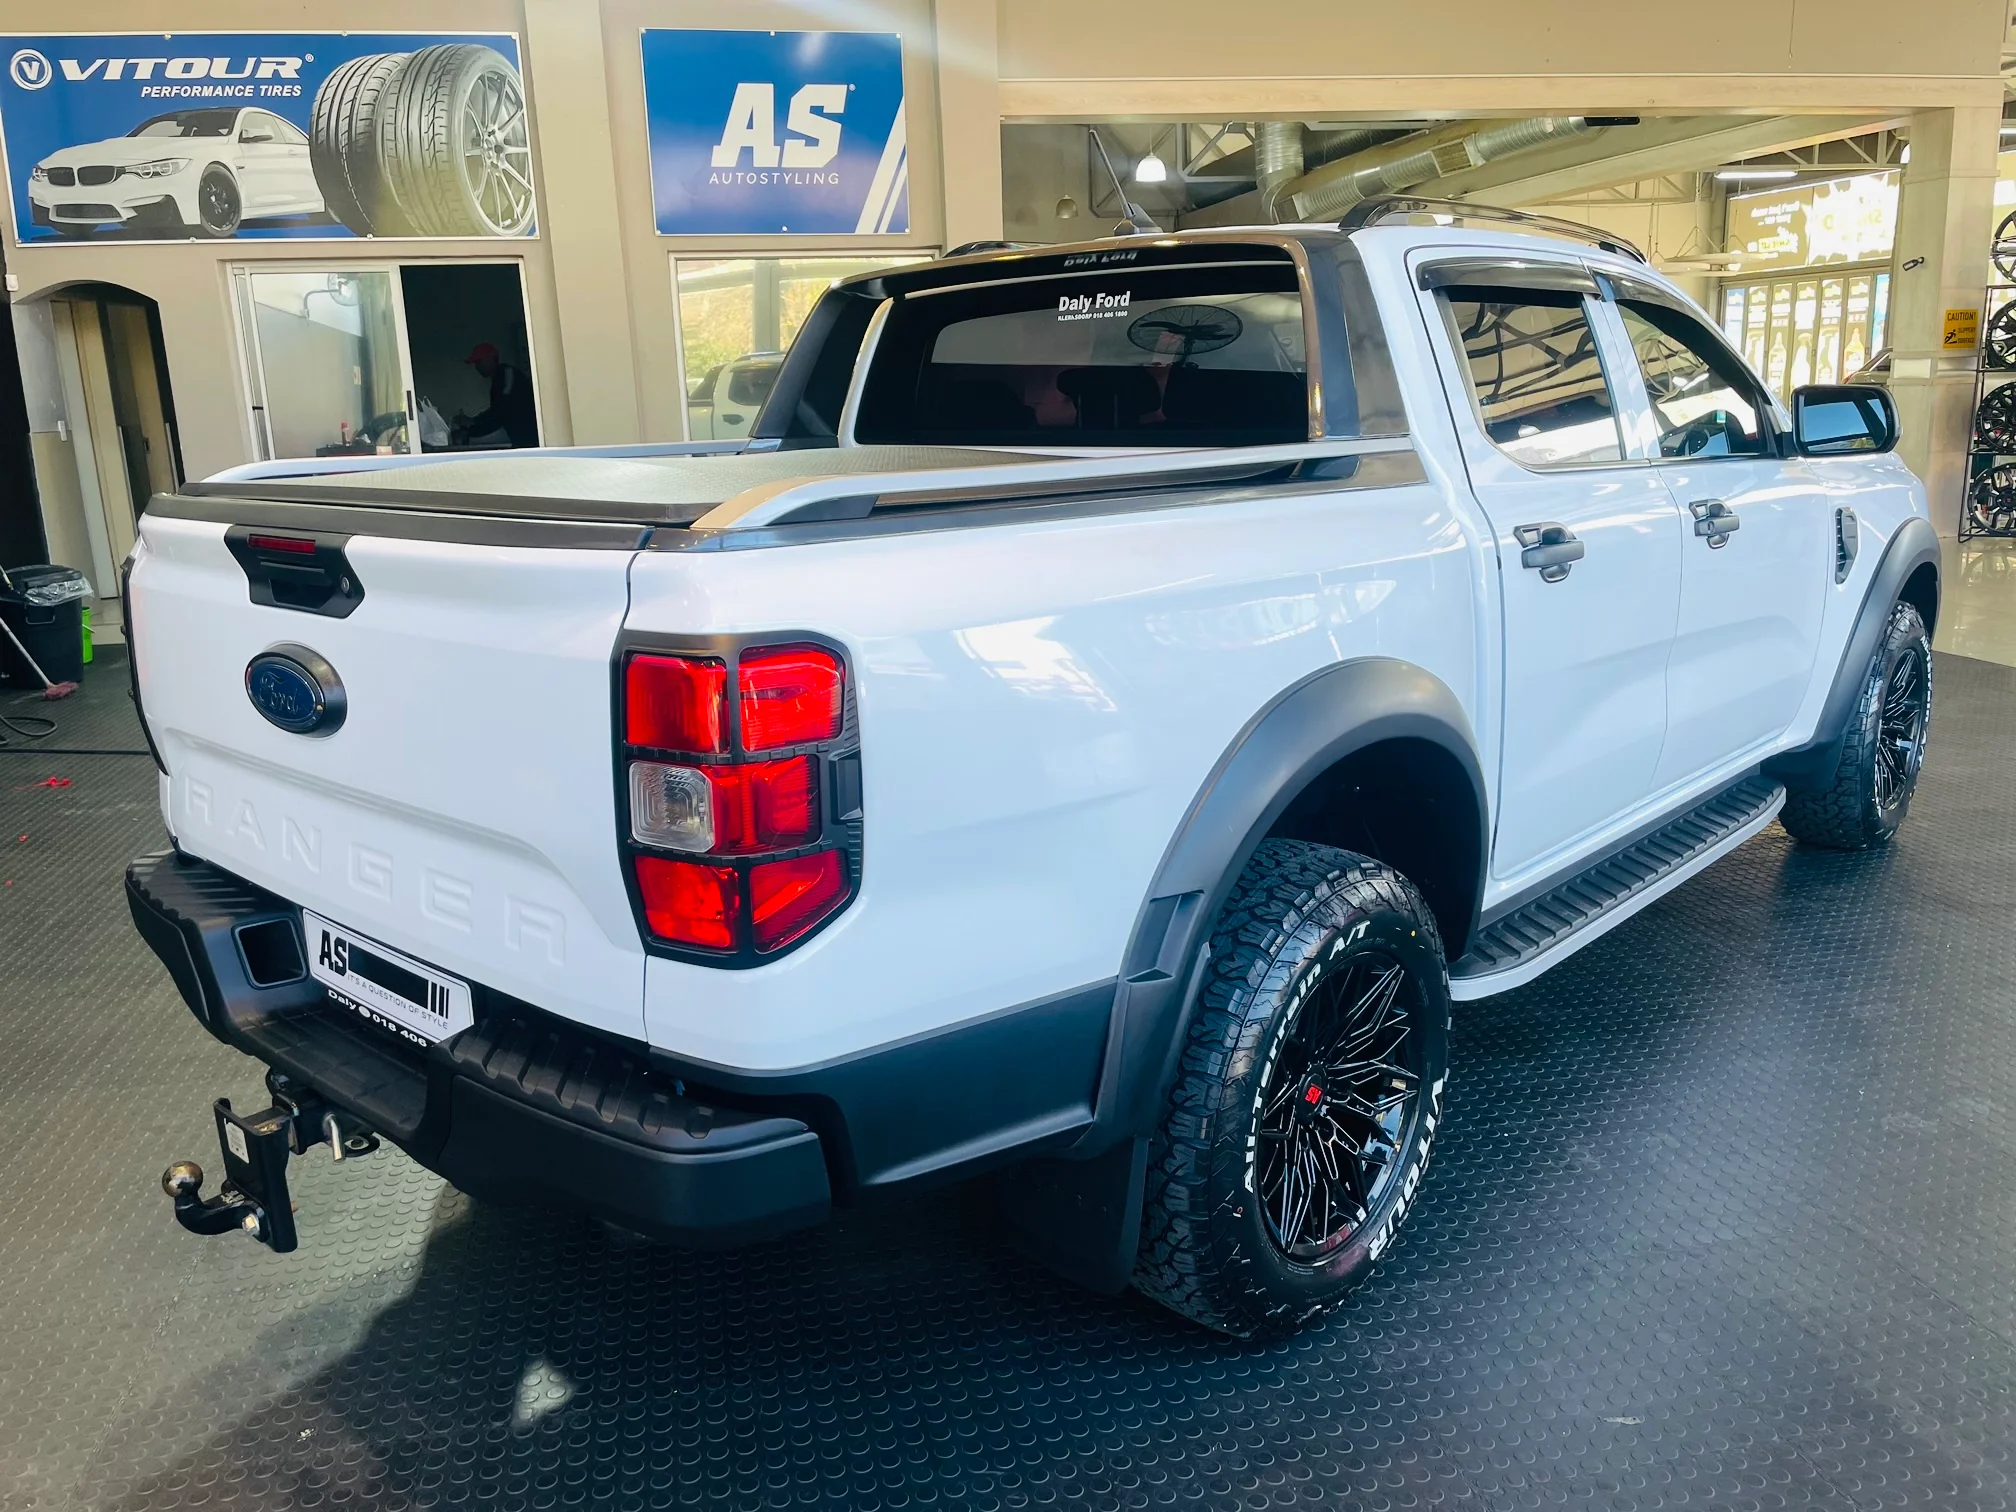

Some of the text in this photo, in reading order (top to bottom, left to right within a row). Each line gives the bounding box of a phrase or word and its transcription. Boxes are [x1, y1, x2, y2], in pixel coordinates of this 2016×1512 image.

[58, 57, 303, 81] VITOUR
[140, 84, 302, 98] PERFORMANCE TIRES
[710, 82, 848, 168] AS
[709, 172, 839, 185] AUTOSTYLING
[1058, 291, 1131, 313] Daly Ford
[1947, 312, 1977, 322] CAUTION!
[184, 774, 567, 968] RANGER
[319, 928, 347, 977] AS
[1329, 919, 1371, 961] A/T
[327, 988, 428, 1048] Daly 018 406
[347, 974, 360, 985] IT'S
[368, 984, 407, 1009] QUESTION
[408, 1003, 420, 1014] OF
[421, 1010, 449, 1031] STYLE
